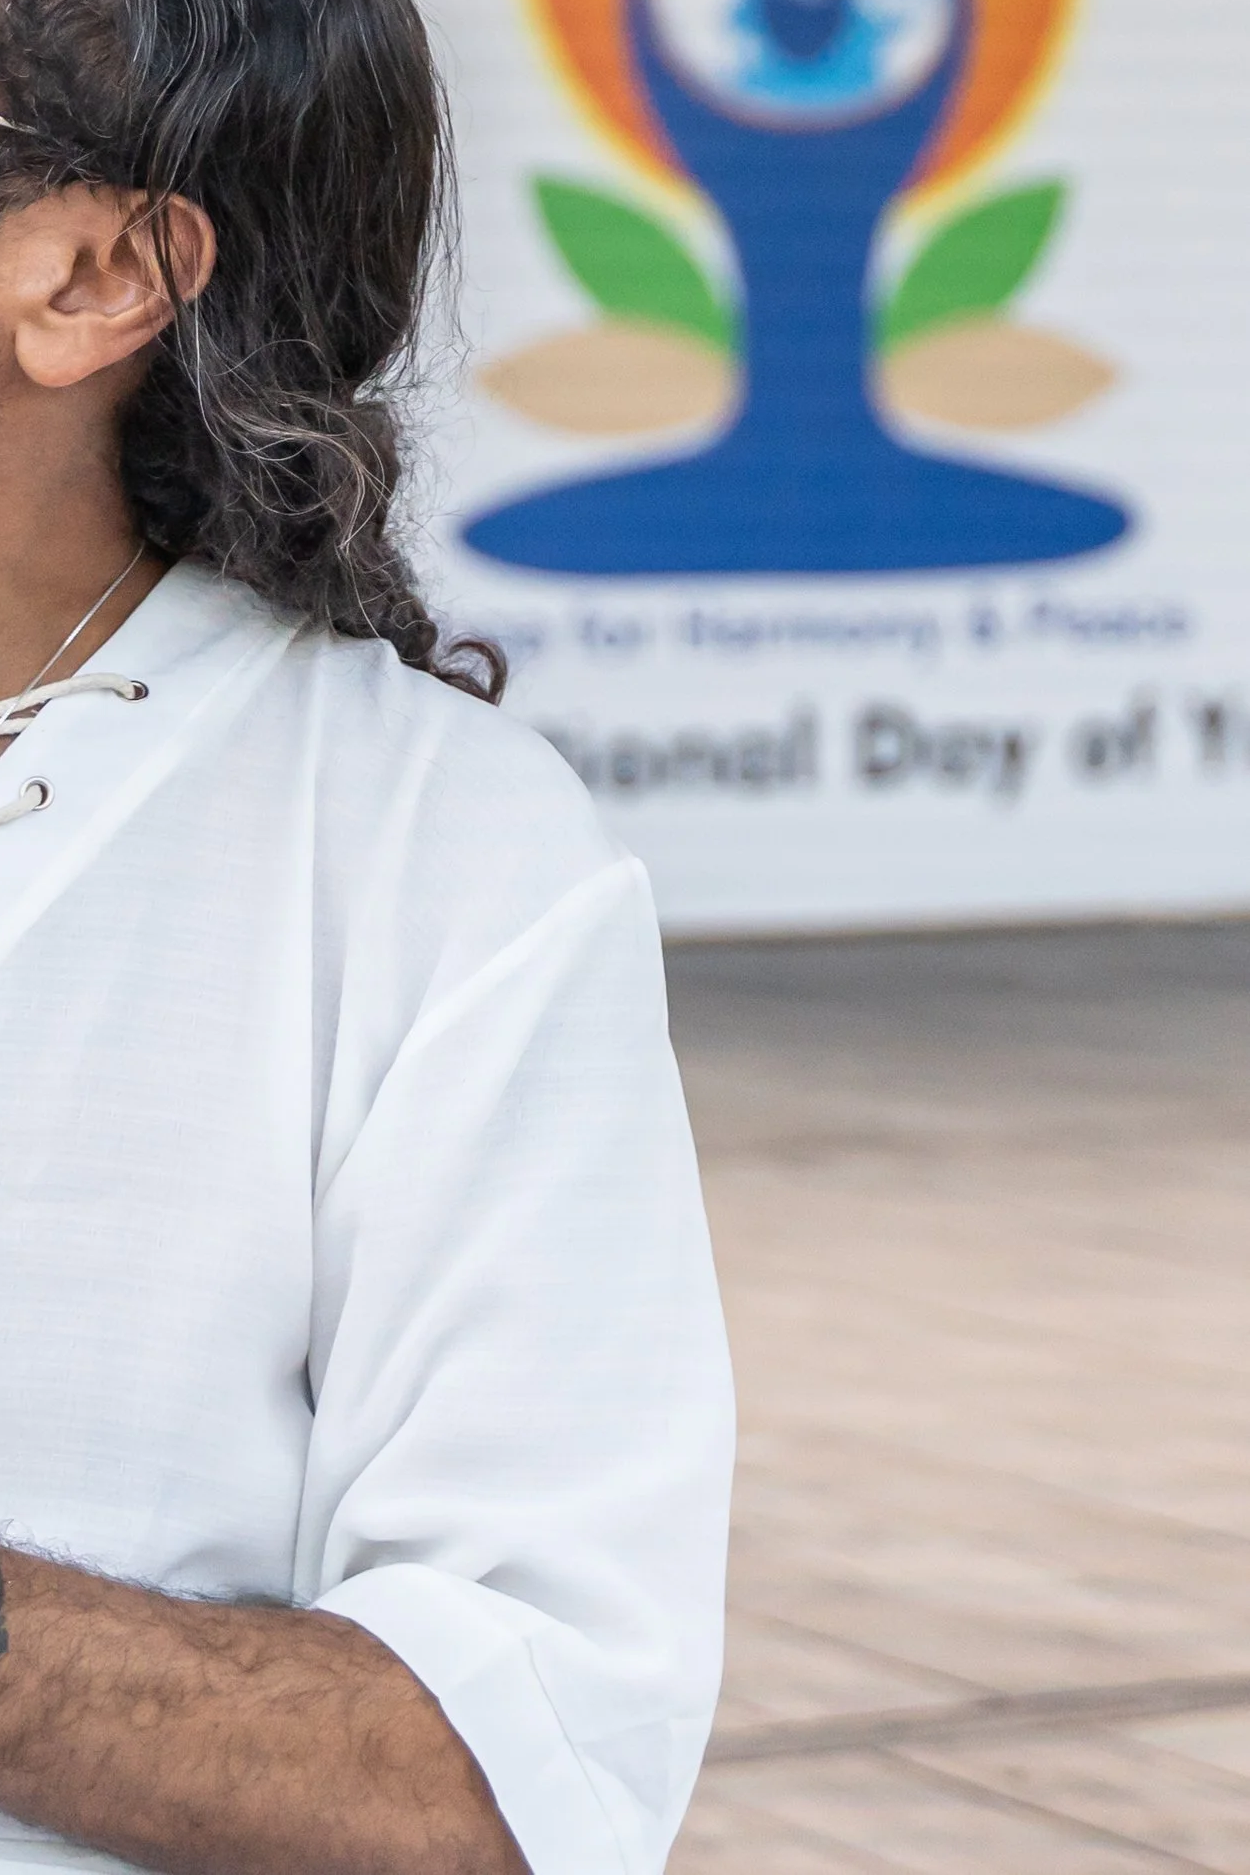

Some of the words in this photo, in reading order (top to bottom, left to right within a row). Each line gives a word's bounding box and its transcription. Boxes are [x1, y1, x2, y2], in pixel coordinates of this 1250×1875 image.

[854, 699, 1036, 809] Day
[1068, 685, 1160, 785] of
[1184, 691, 1250, 779] Y
